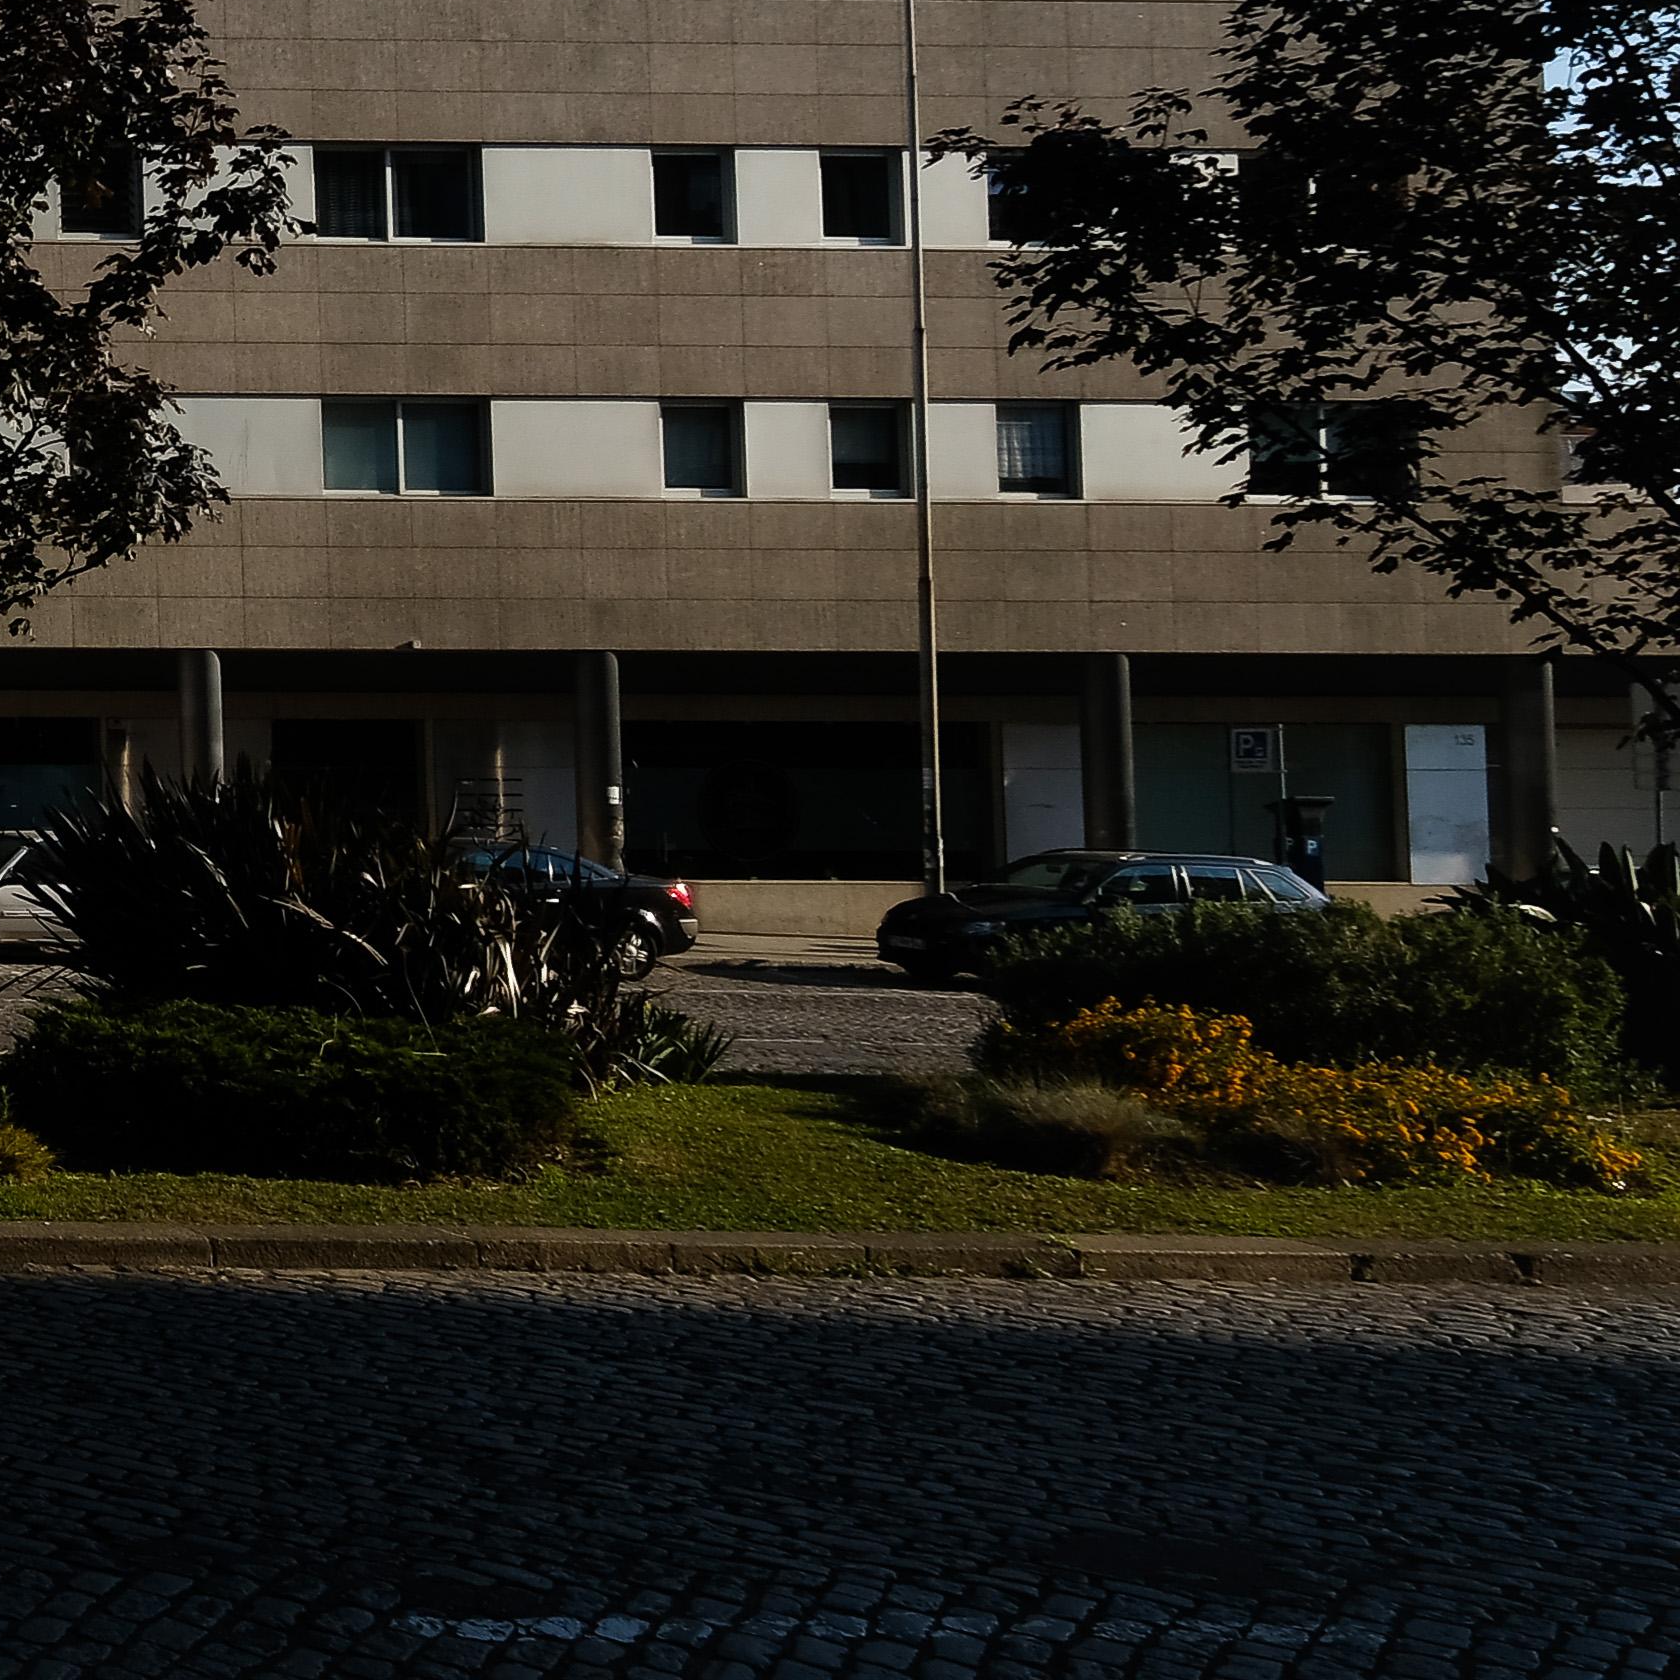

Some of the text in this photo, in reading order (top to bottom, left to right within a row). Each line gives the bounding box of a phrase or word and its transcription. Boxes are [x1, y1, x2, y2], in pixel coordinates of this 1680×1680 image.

[1239, 734, 1255, 757] P
[1454, 734, 1476, 746] 135
[1307, 840, 1318, 854] P
